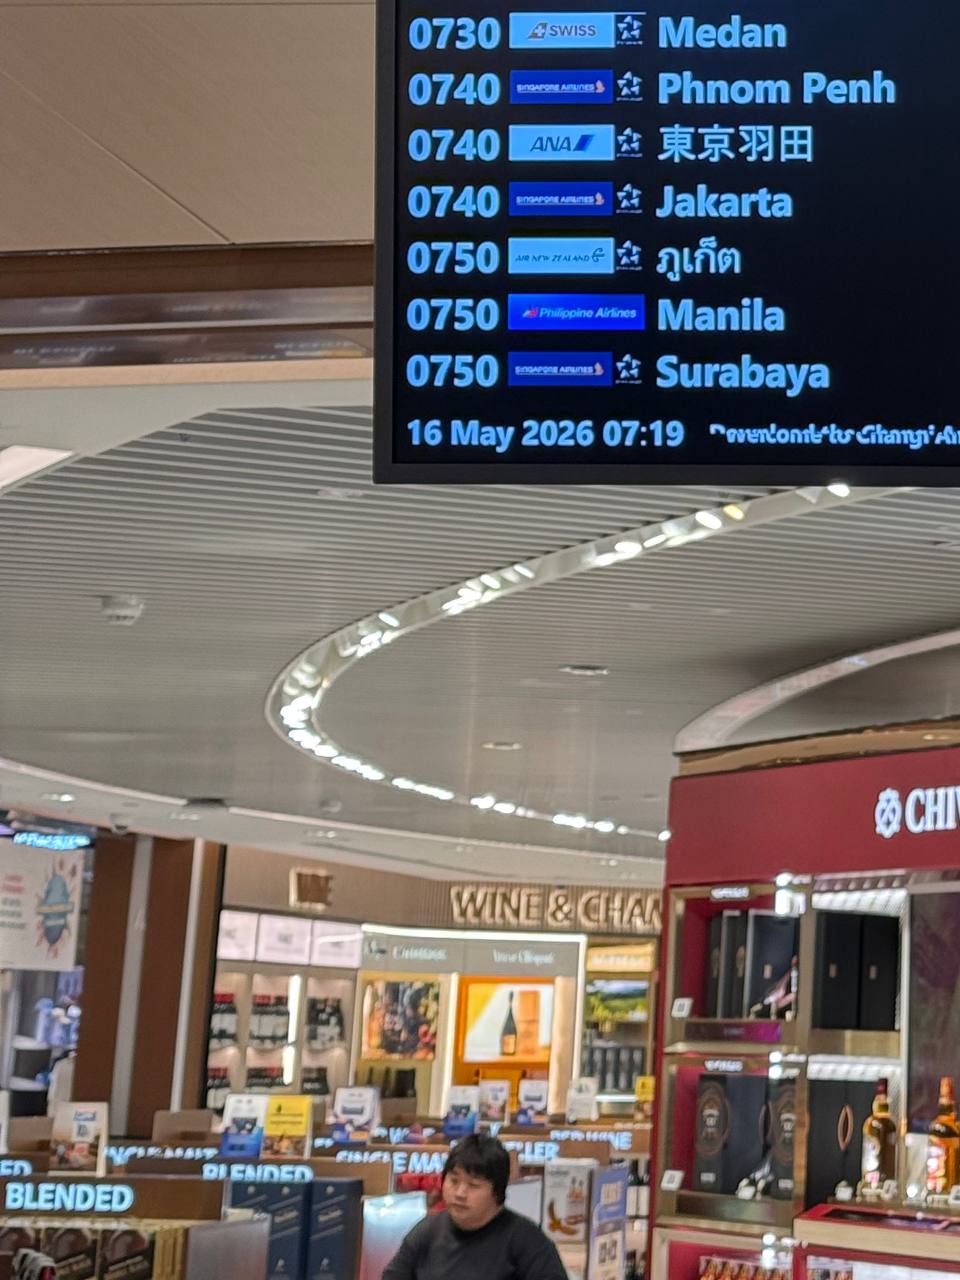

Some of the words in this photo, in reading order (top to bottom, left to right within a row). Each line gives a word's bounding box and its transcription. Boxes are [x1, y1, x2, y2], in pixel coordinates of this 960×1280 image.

[409, 17, 501, 49] 0730
[550, 25, 596, 36] SWISS
[659, 15, 786, 48] Medan
[409, 73, 500, 105] 0740
[659, 71, 790, 104] Phnom
[804, 70, 895, 103] Penh
[408, 129, 500, 161] 0740
[530, 136, 571, 152] ANA
[658, 124, 812, 162] 東京羽田
[408, 186, 500, 217] 0740
[656, 184, 792, 217] Jakarta
[407, 242, 500, 274] 0750
[656, 236, 741, 281] ภูเก็ต
[407, 298, 499, 330] 0750
[658, 297, 785, 331] Manila
[407, 355, 499, 387] 0750
[656, 354, 830, 397] Surabaya
[408, 419, 442, 446] 16
[451, 420, 515, 453] May
[522, 420, 594, 446] 2026
[603, 420, 684, 446] 07:19
[450, 885, 543, 926] WINE
[549, 888, 573, 927] &
[6, 1183, 133, 1211] BLENDED
